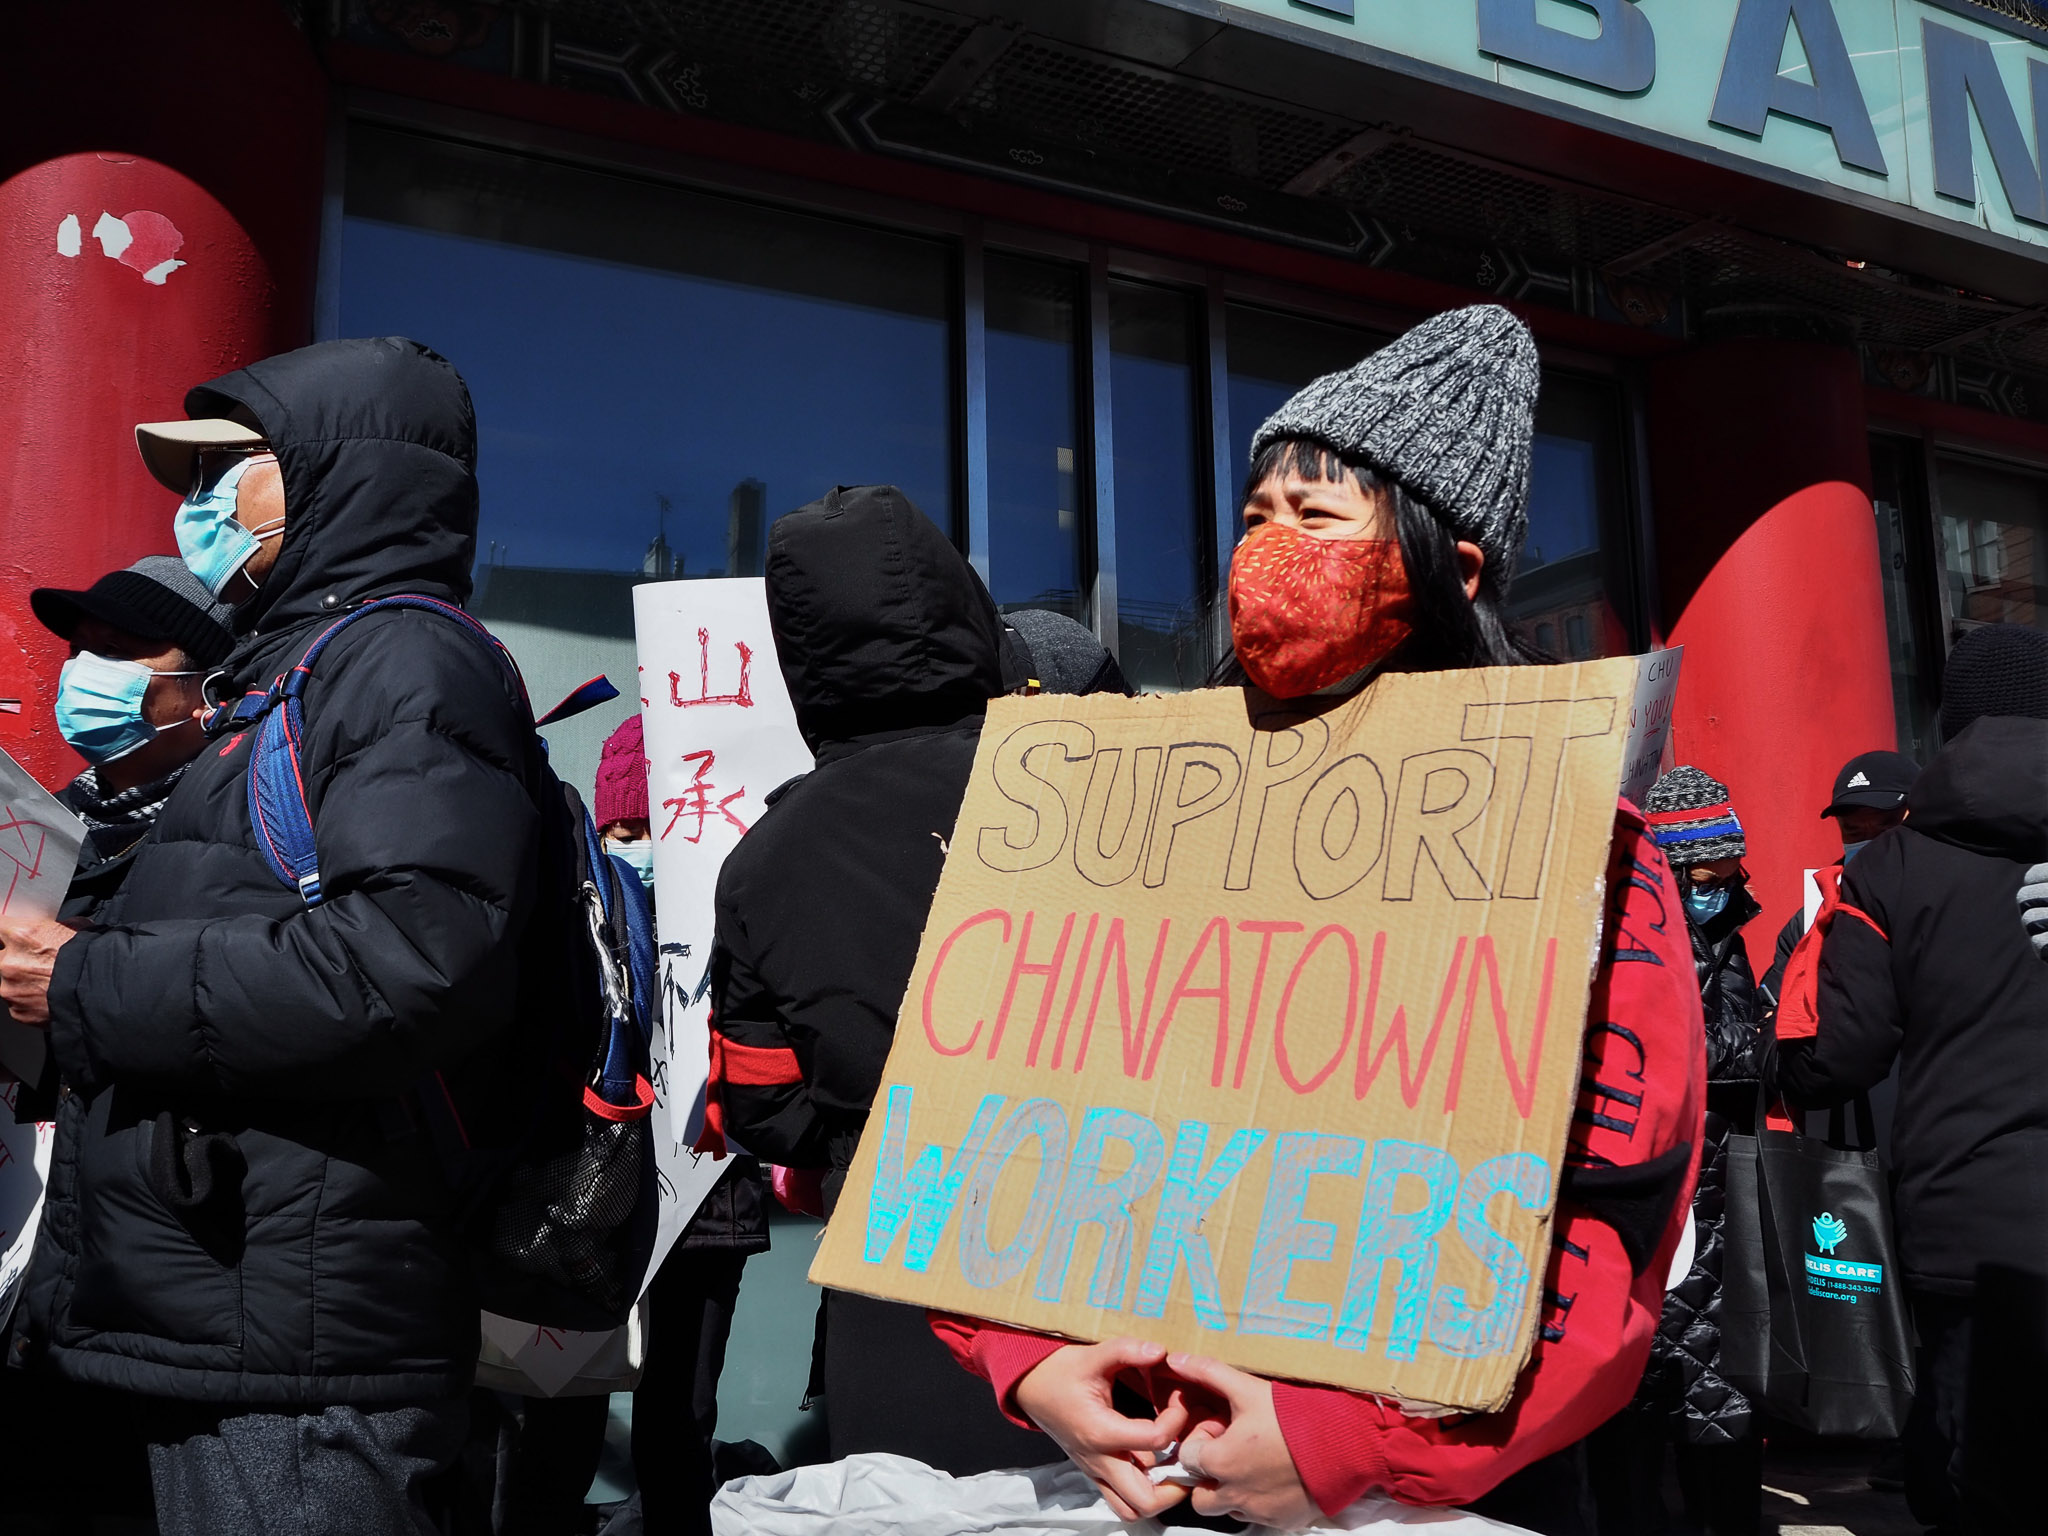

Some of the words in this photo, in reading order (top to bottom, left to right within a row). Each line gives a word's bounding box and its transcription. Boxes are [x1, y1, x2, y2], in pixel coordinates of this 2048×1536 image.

[1478, 0, 2048, 223] BAN
[977, 697, 1617, 900] SUPPORT
[1644, 694, 1671, 728] YOU!
[922, 909, 1557, 1119] CHINATOWN
[863, 1084, 1551, 1362] WORKERS
